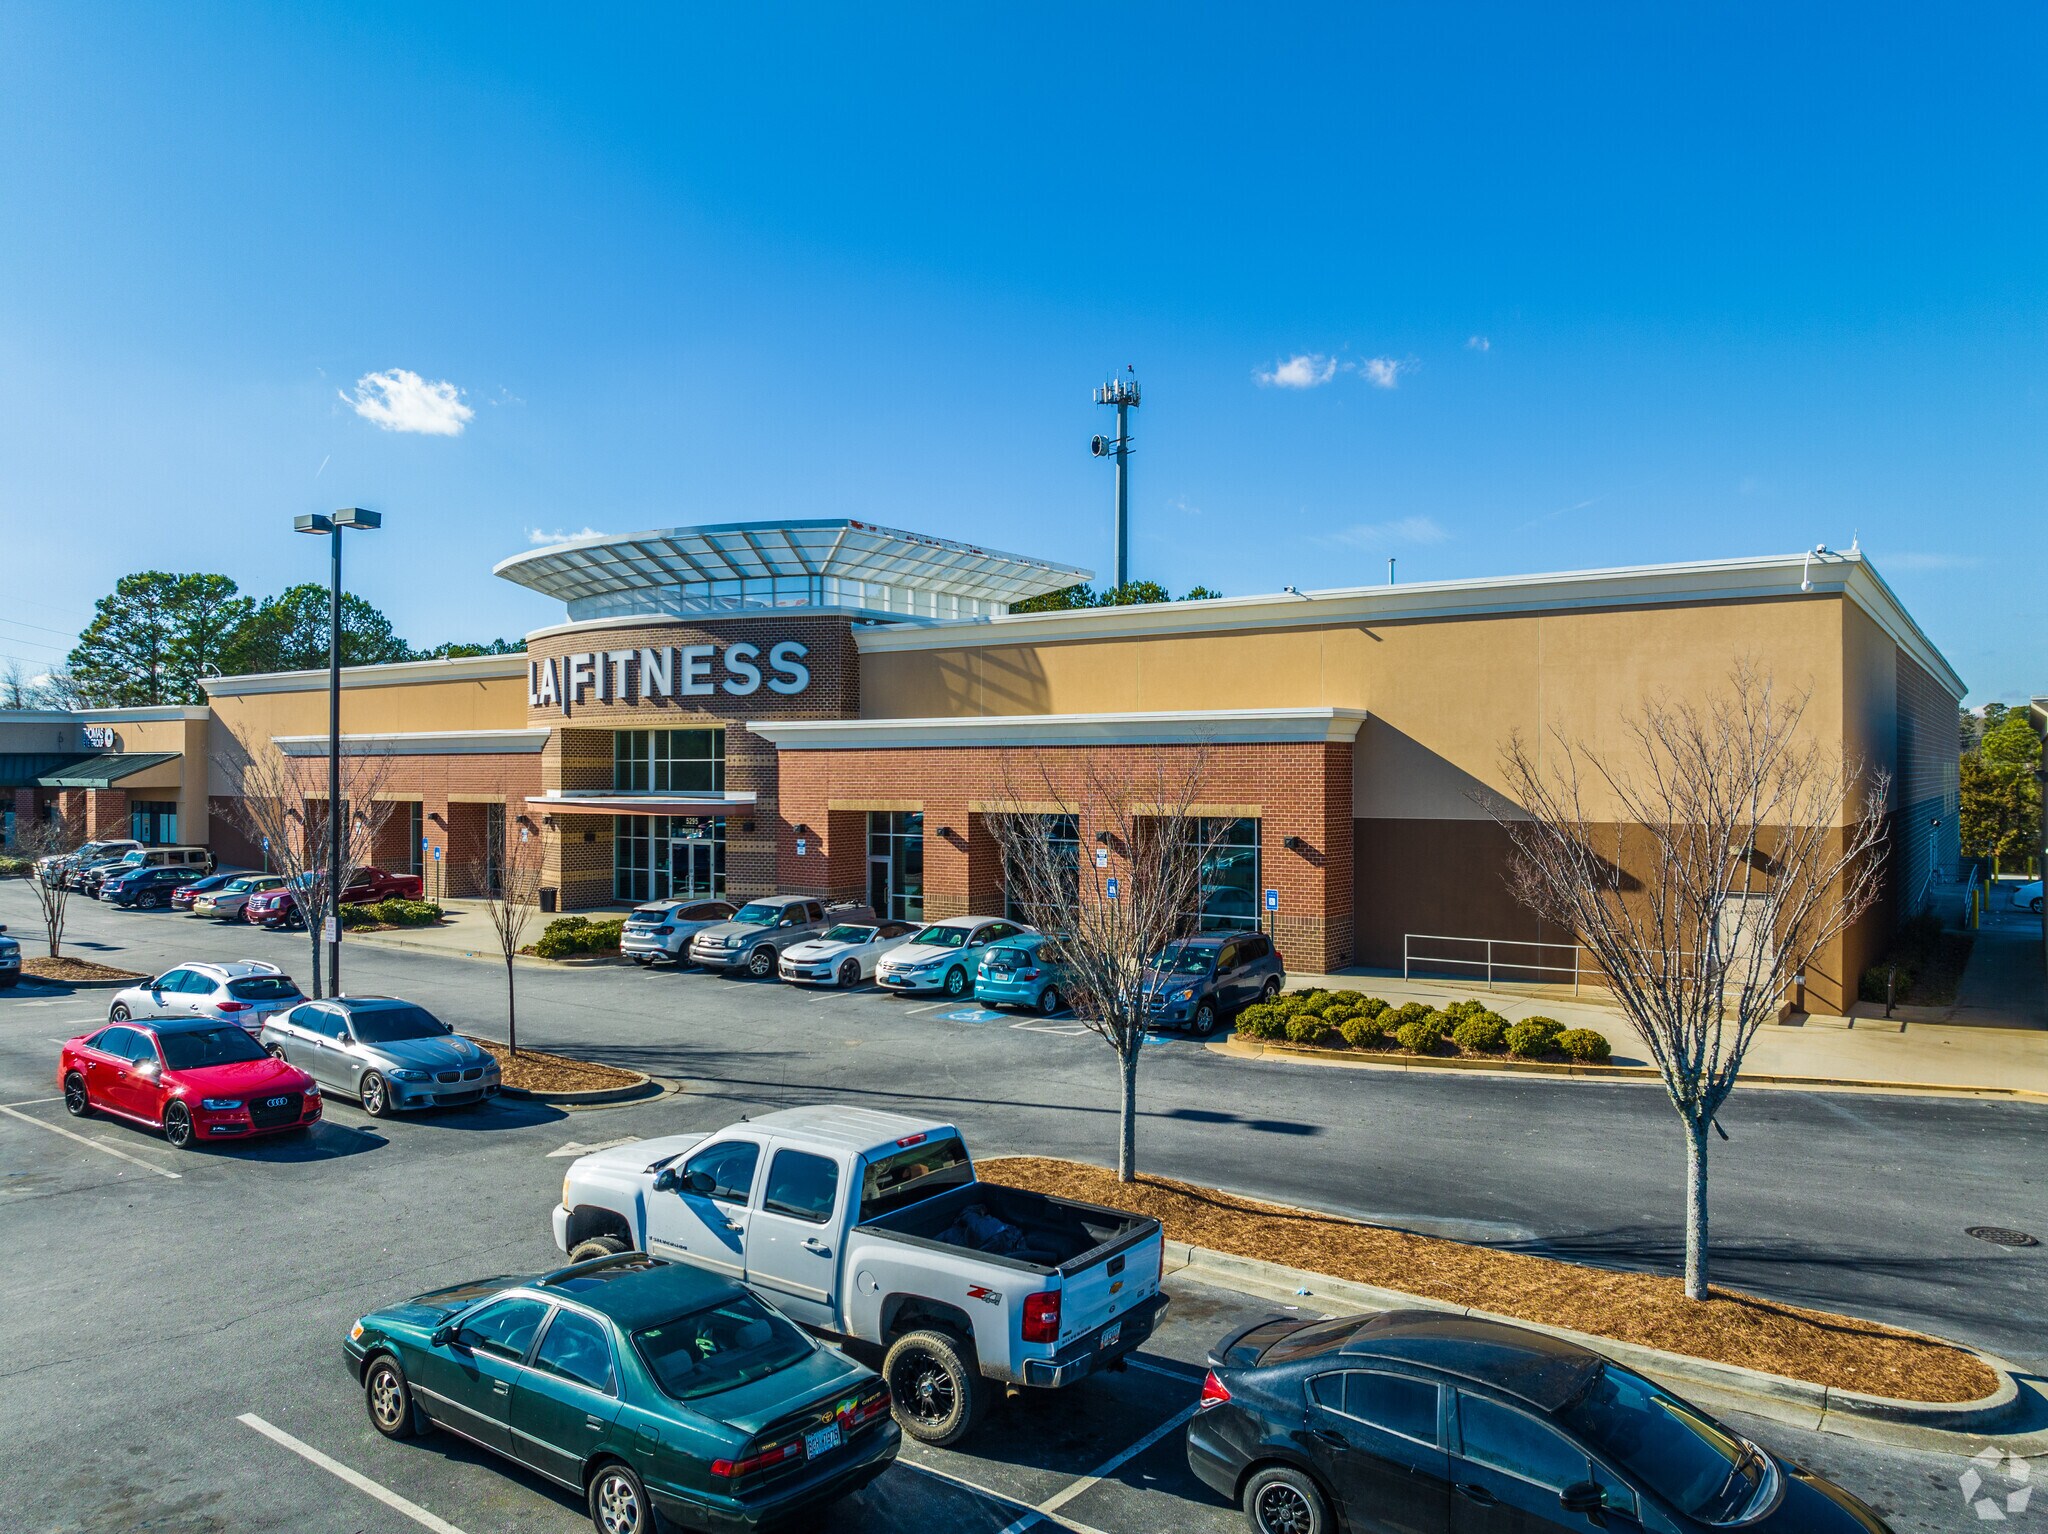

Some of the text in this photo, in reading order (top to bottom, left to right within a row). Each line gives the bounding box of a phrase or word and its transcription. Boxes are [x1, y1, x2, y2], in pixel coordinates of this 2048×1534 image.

[568, 640, 811, 701] FITNESS
[82, 727, 104, 739] THOMAS
[91, 738, 104, 748] GROUP
